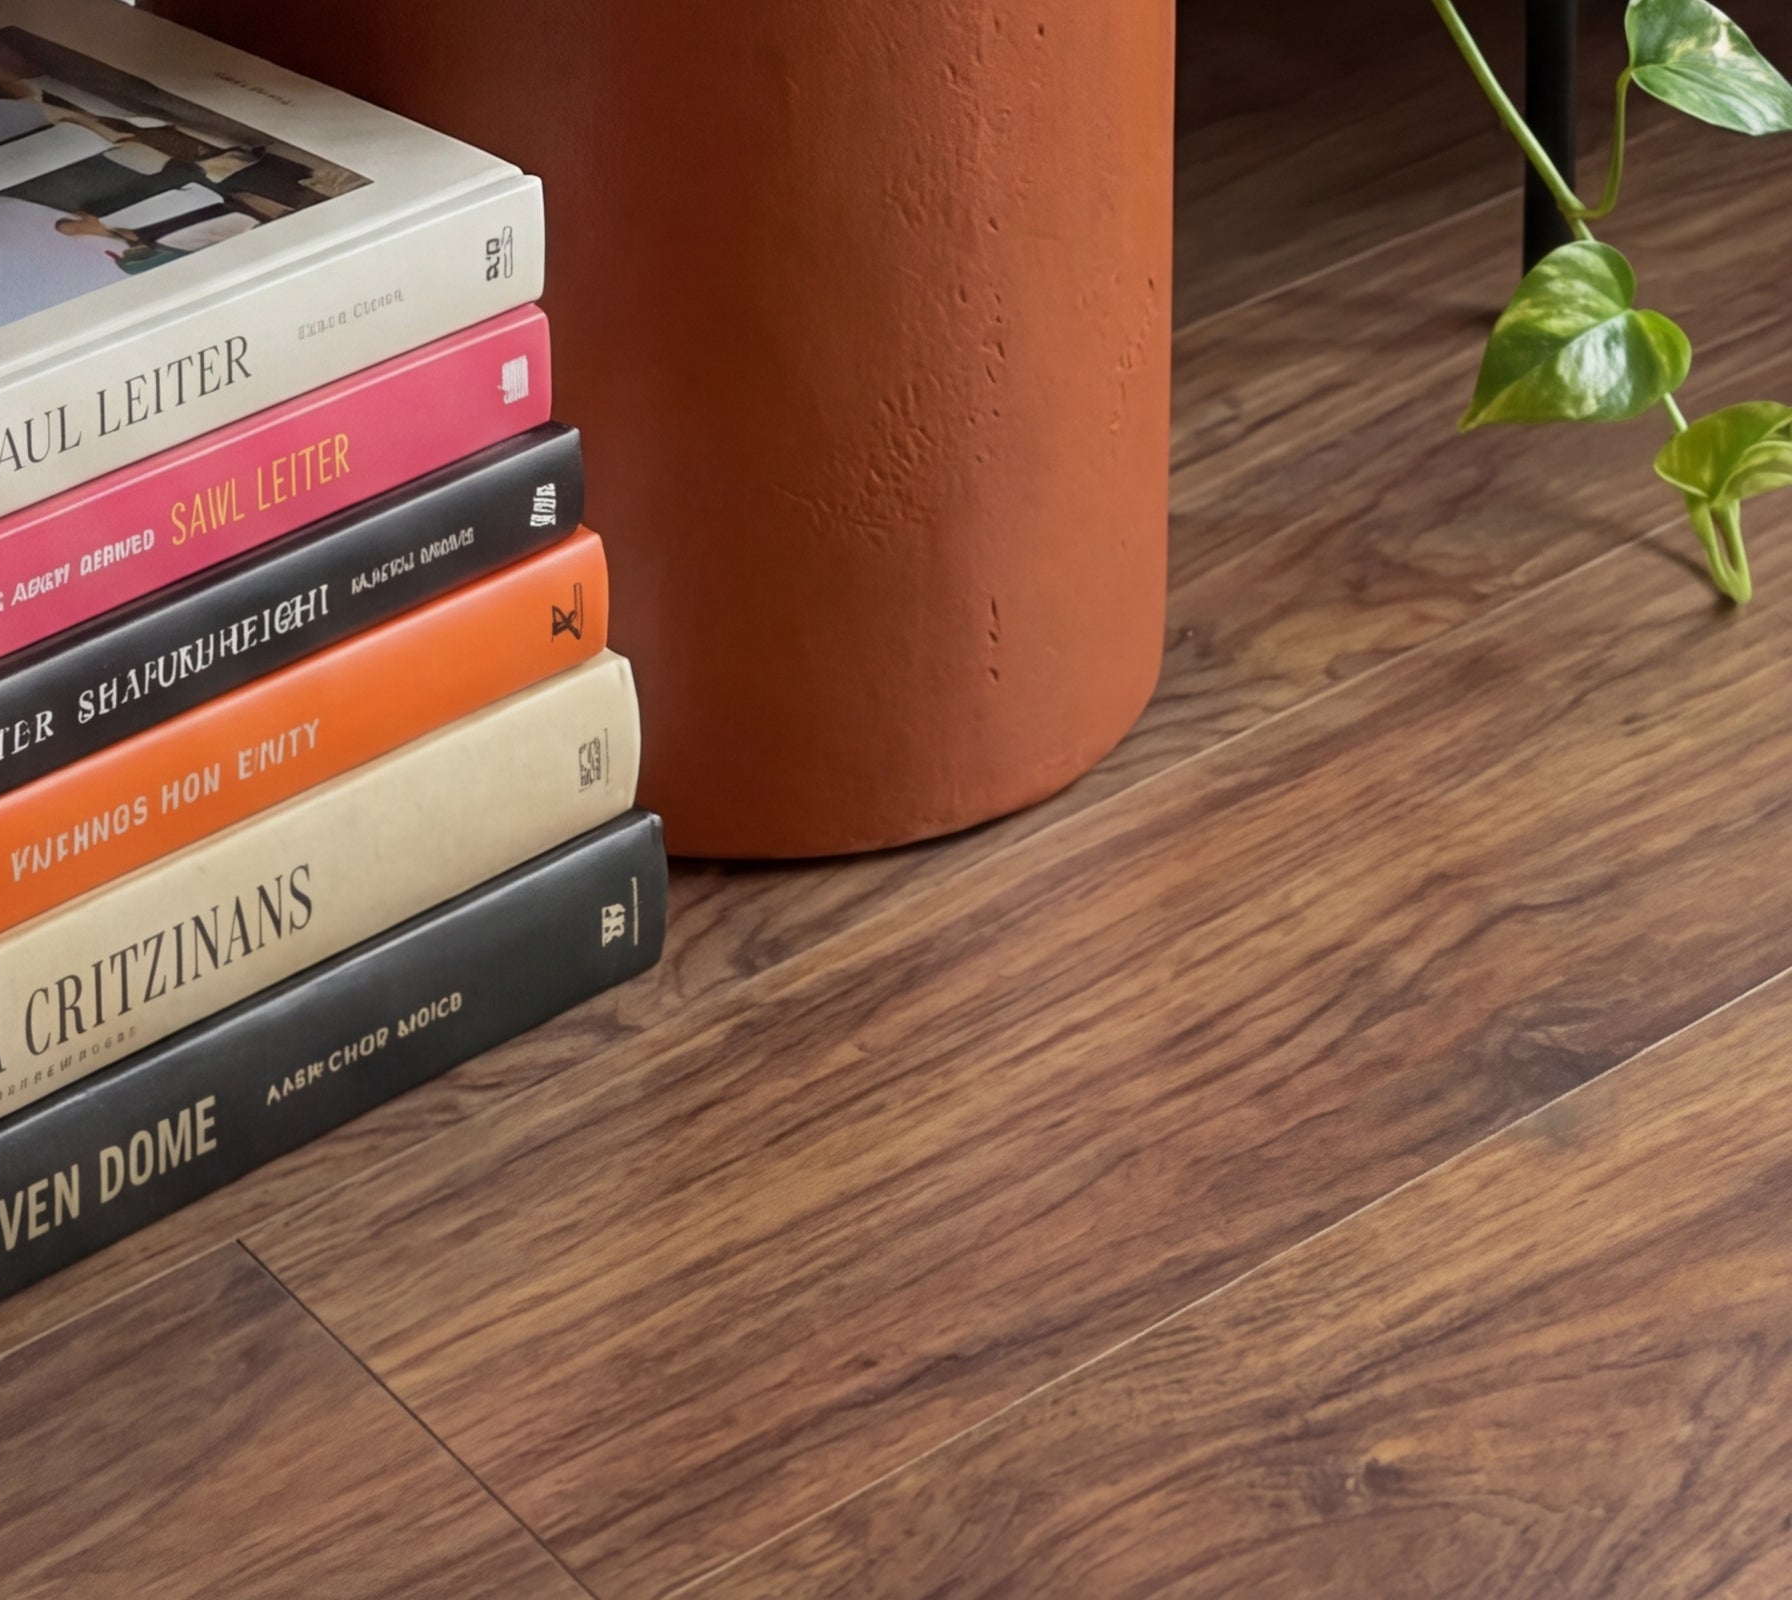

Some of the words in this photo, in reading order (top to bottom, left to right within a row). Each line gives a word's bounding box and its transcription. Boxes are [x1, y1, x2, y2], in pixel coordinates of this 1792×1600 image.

[96, 335, 253, 438] LEITER
[257, 433, 350, 512] LEITER
[161, 763, 221, 814] HON
[100, 1095, 218, 1204] DOME
